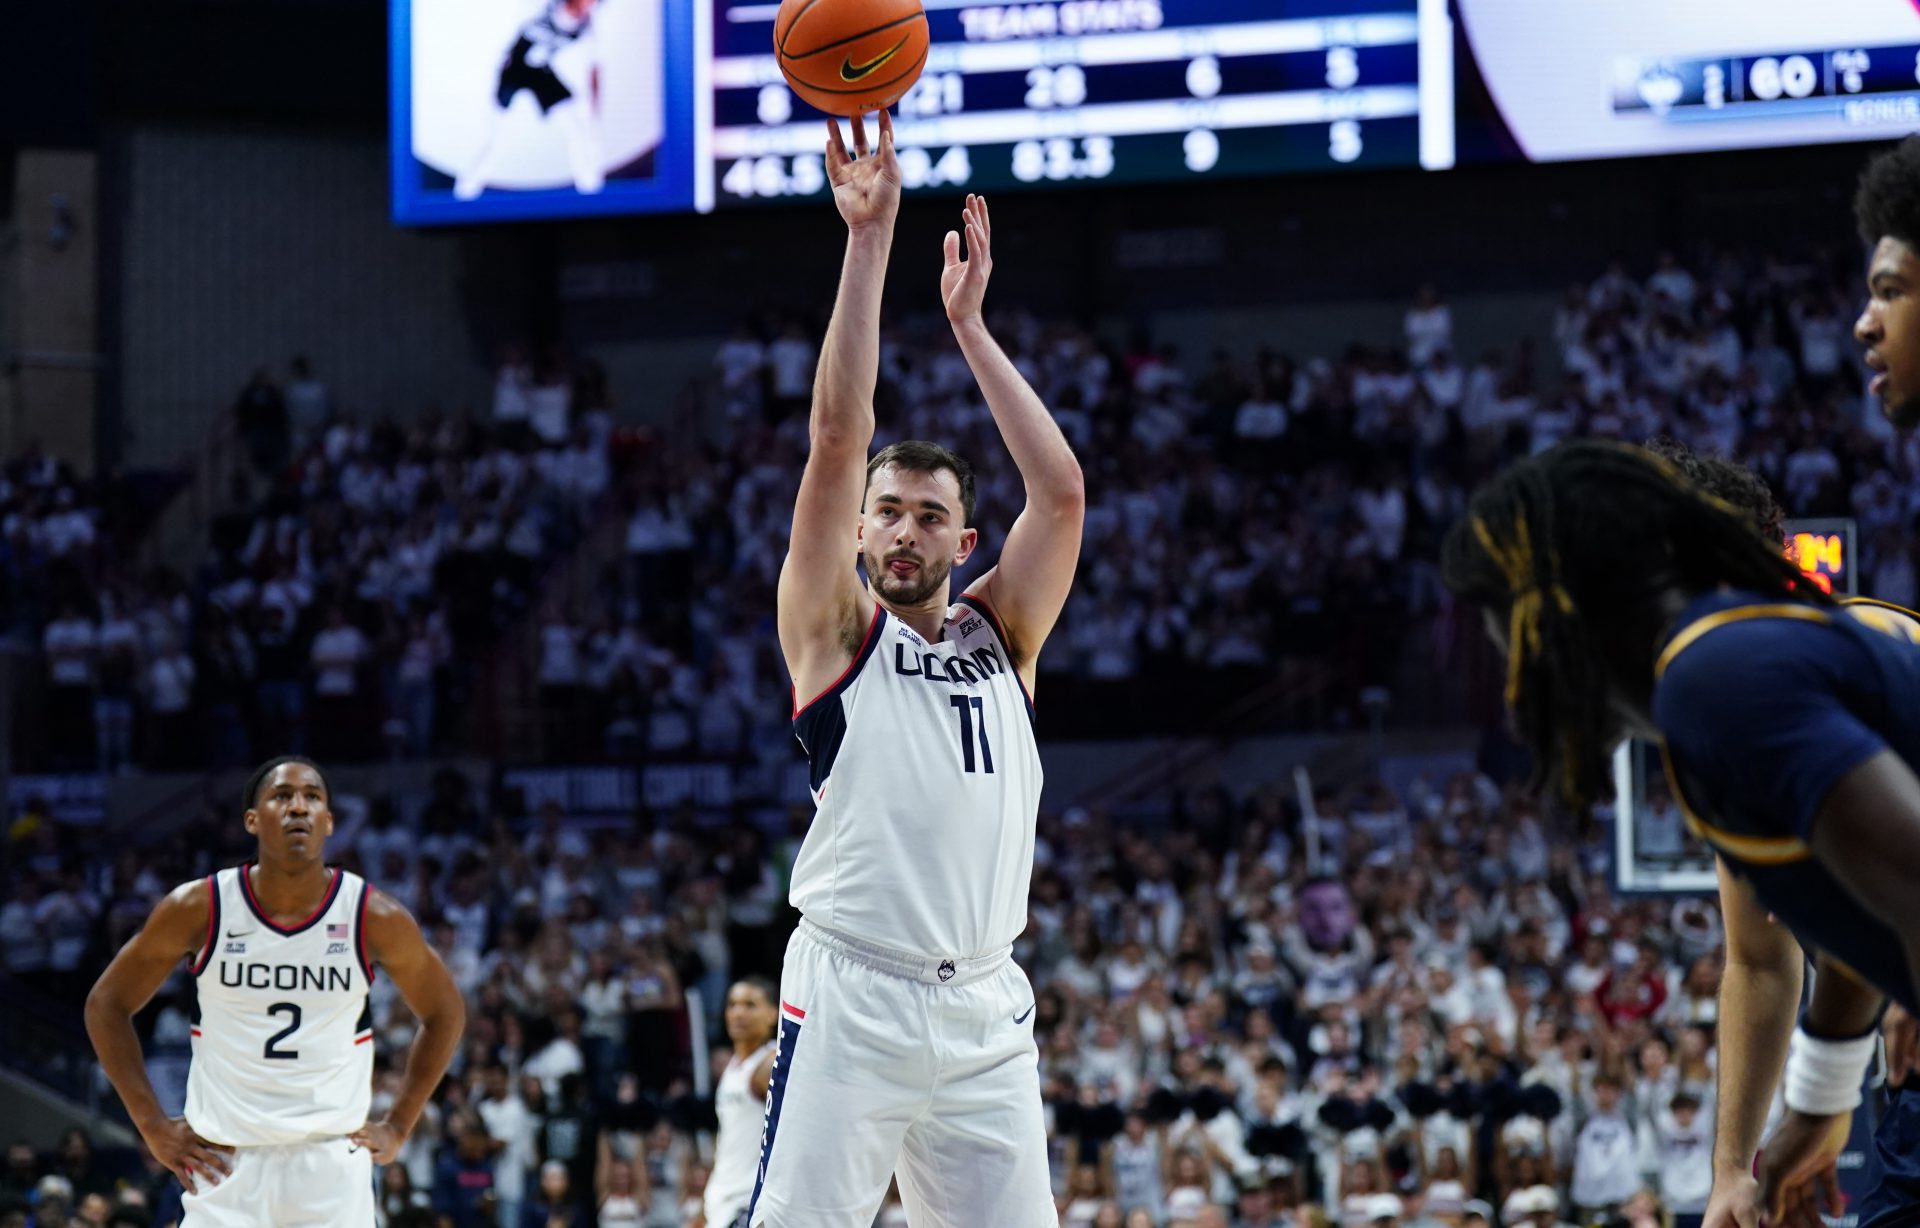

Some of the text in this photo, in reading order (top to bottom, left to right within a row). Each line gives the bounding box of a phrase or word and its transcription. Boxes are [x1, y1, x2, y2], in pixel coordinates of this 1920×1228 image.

[959, 0, 1163, 40] TEAM STATS
[898, 630, 922, 648] CHANGE
[959, 617, 975, 630] BIG
[961, 619, 983, 636] EAST
[896, 643, 1004, 686] UCONN
[950, 694, 994, 773] 11
[220, 961, 351, 992] UCONN
[264, 1002, 302, 1059] 2
